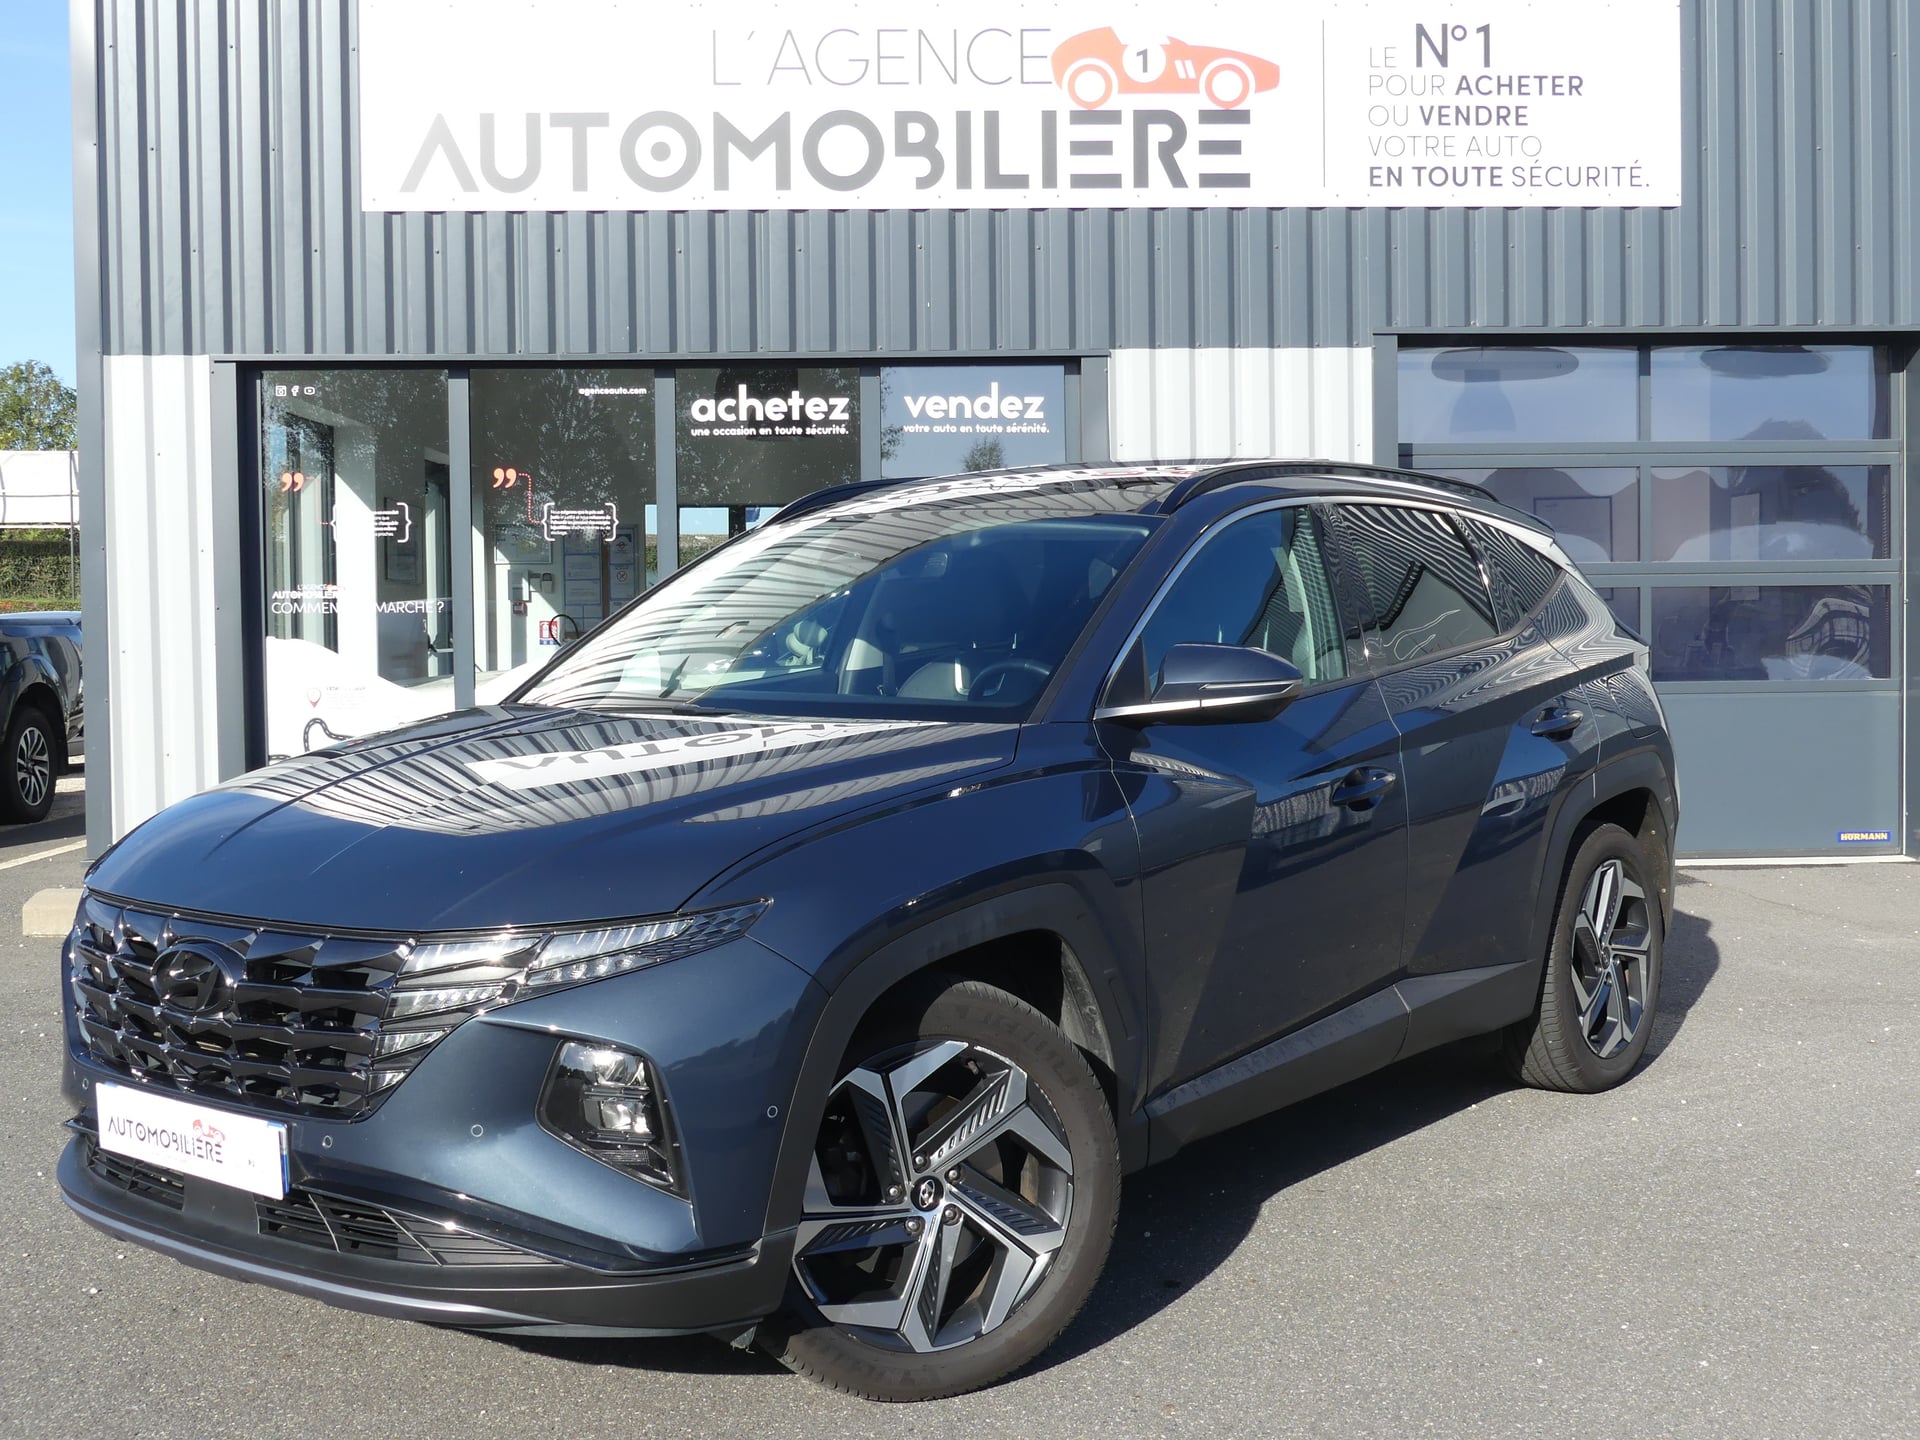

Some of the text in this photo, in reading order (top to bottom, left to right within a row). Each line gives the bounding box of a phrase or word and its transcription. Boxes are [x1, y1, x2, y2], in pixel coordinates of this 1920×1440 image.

[1136, 48, 1148, 73] 1
[1368, 46, 1397, 69] LE
[1369, 74, 1584, 97] POUR ACHETER
[1368, 105, 1529, 127] OU VENDRE
[1368, 135, 1542, 158] VOTRE AUTO
[1369, 159, 1651, 188] EN TOUTE SÉCURITÉ.
[578, 387, 647, 397] agenceauto.com
[691, 384, 850, 422] achetez
[904, 382, 1045, 419] vendez
[691, 428, 710, 436] une
[713, 426, 756, 436] occasion
[759, 428, 772, 436] en
[775, 425, 803, 436] toute
[904, 424, 931, 433] votre
[933, 424, 957, 433] auto
[960, 425, 973, 433] en
[976, 423, 1003, 433] toute
